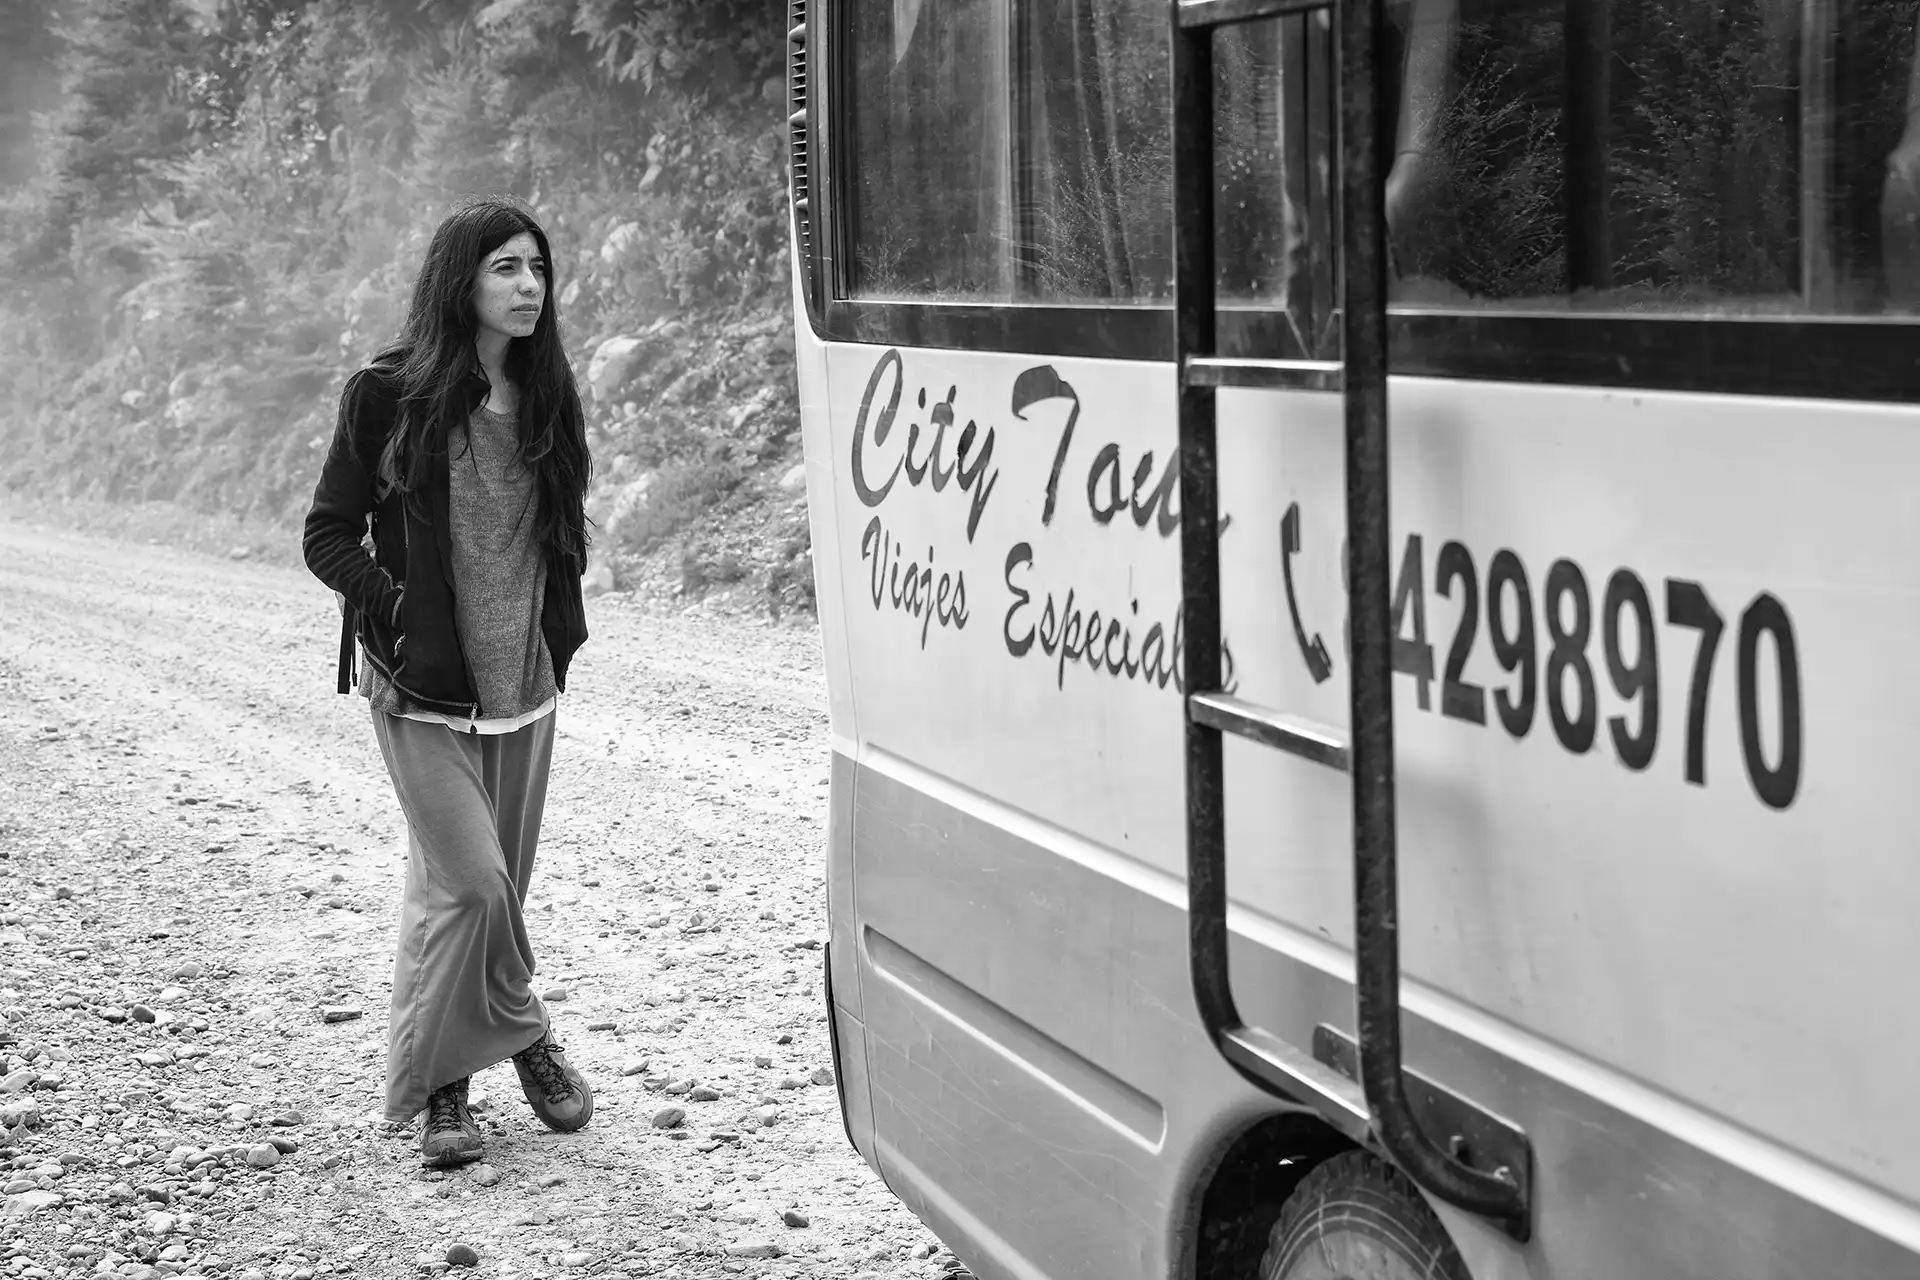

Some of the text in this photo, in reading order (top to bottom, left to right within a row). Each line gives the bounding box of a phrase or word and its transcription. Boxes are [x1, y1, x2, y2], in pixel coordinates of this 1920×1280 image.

[852, 348, 1231, 544] City Tou
[861, 515, 970, 651] Viajes
[1341, 531, 1804, 811] 4298970
